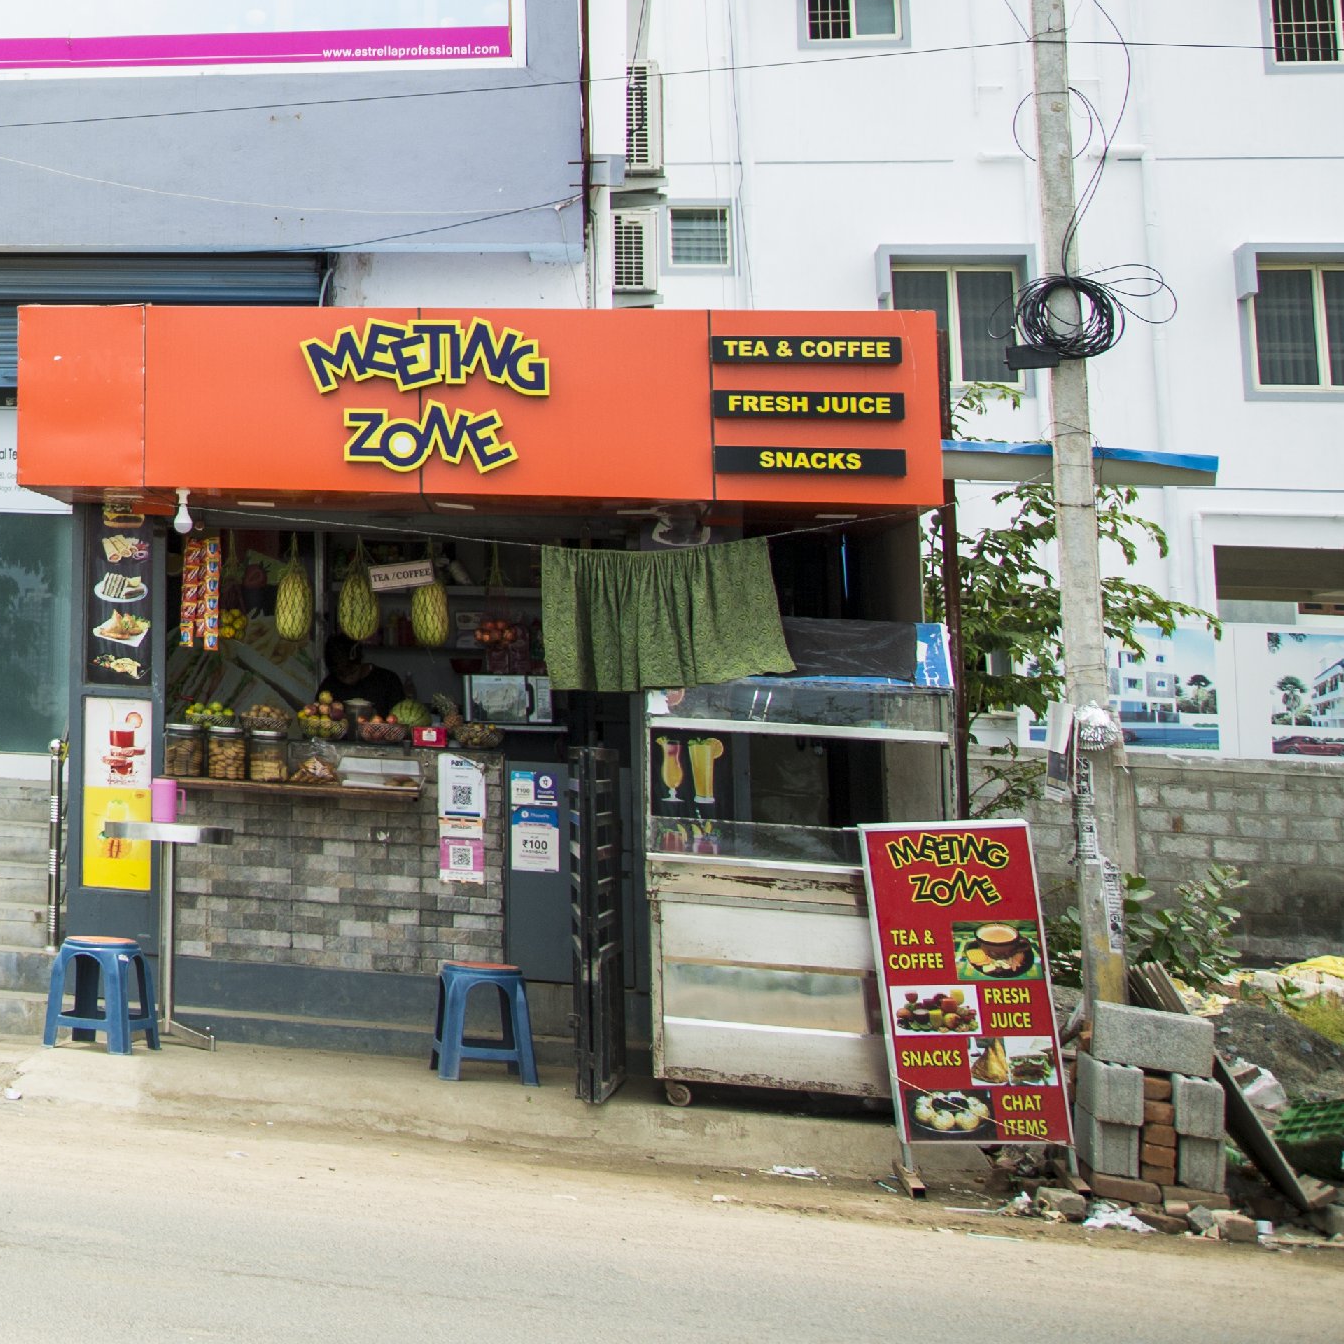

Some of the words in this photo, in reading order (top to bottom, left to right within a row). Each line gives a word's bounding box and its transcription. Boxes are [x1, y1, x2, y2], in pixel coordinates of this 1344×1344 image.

[322, 43, 500, 59] www.estrellaprofessional.com
[301, 317, 550, 397] MEETING
[722, 340, 765, 361] TEA
[769, 340, 792, 360] &
[800, 338, 892, 360] COFFEE
[727, 395, 809, 414] FRESH
[816, 393, 892, 415] JUICE
[343, 399, 518, 474] ZONE
[759, 450, 863, 472] SNACKS
[372, 573, 390, 583] TEA
[521, 839, 549, 852] ₹100
[886, 833, 1010, 870] MEETING
[910, 868, 1003, 907] ZONE
[890, 929, 920, 946] TEA
[924, 929, 935, 946] &
[889, 953, 945, 971] COFFEE
[984, 987, 1032, 1005] FRESH
[989, 1011, 1033, 1029] JUICE
[901, 1049, 962, 1068] SNACKS
[1001, 1094, 1042, 1112] CHAT
[1003, 1119, 1049, 1136] ITEMS
